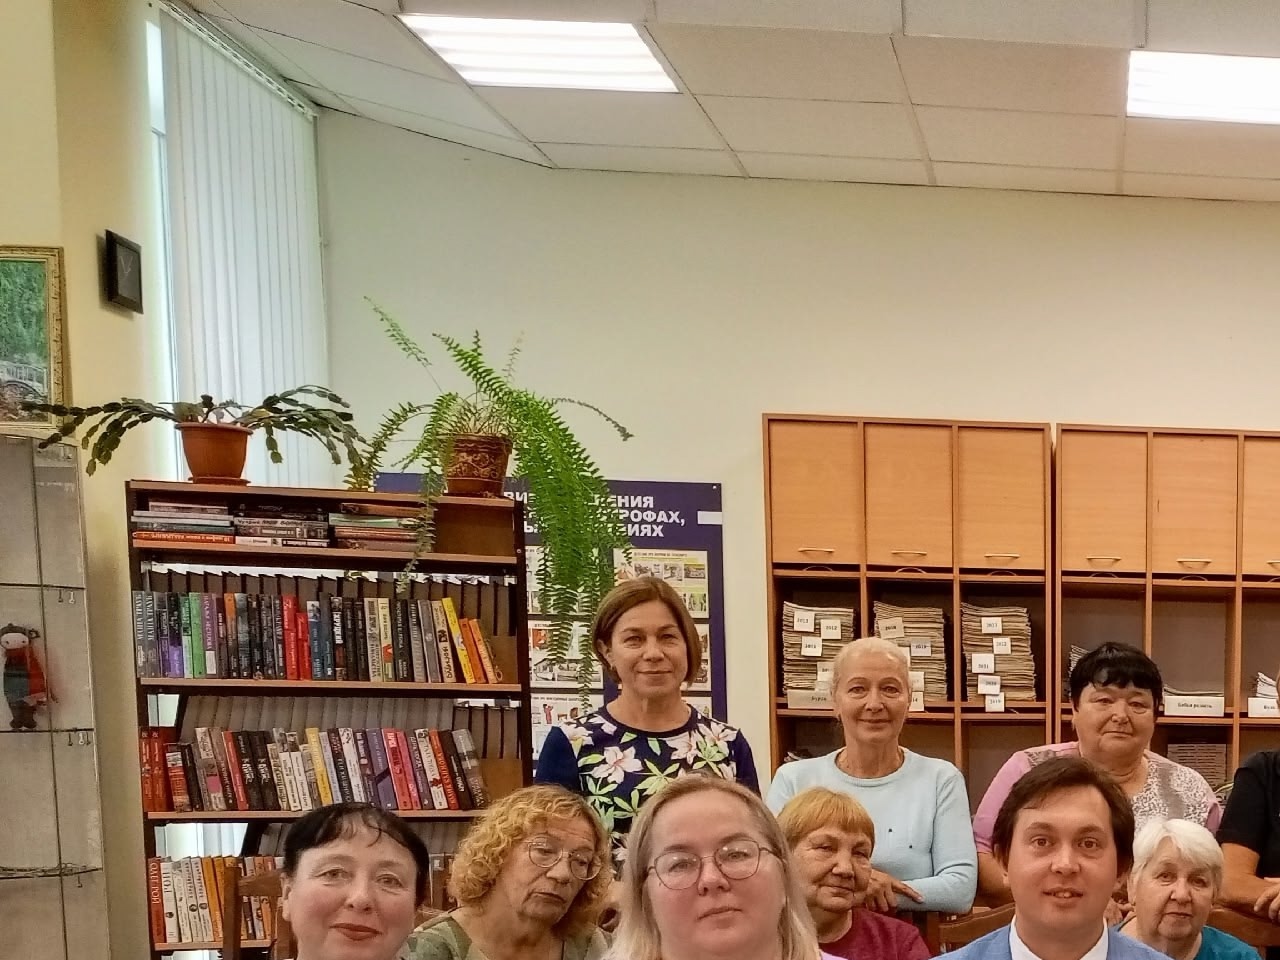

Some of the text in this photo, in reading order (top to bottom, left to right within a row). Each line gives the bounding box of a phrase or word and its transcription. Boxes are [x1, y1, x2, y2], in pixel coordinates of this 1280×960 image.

[333, 613, 343, 645] ХРУЦКИЙ
[150, 863, 161, 904] ОЛЕГ РОЙ
